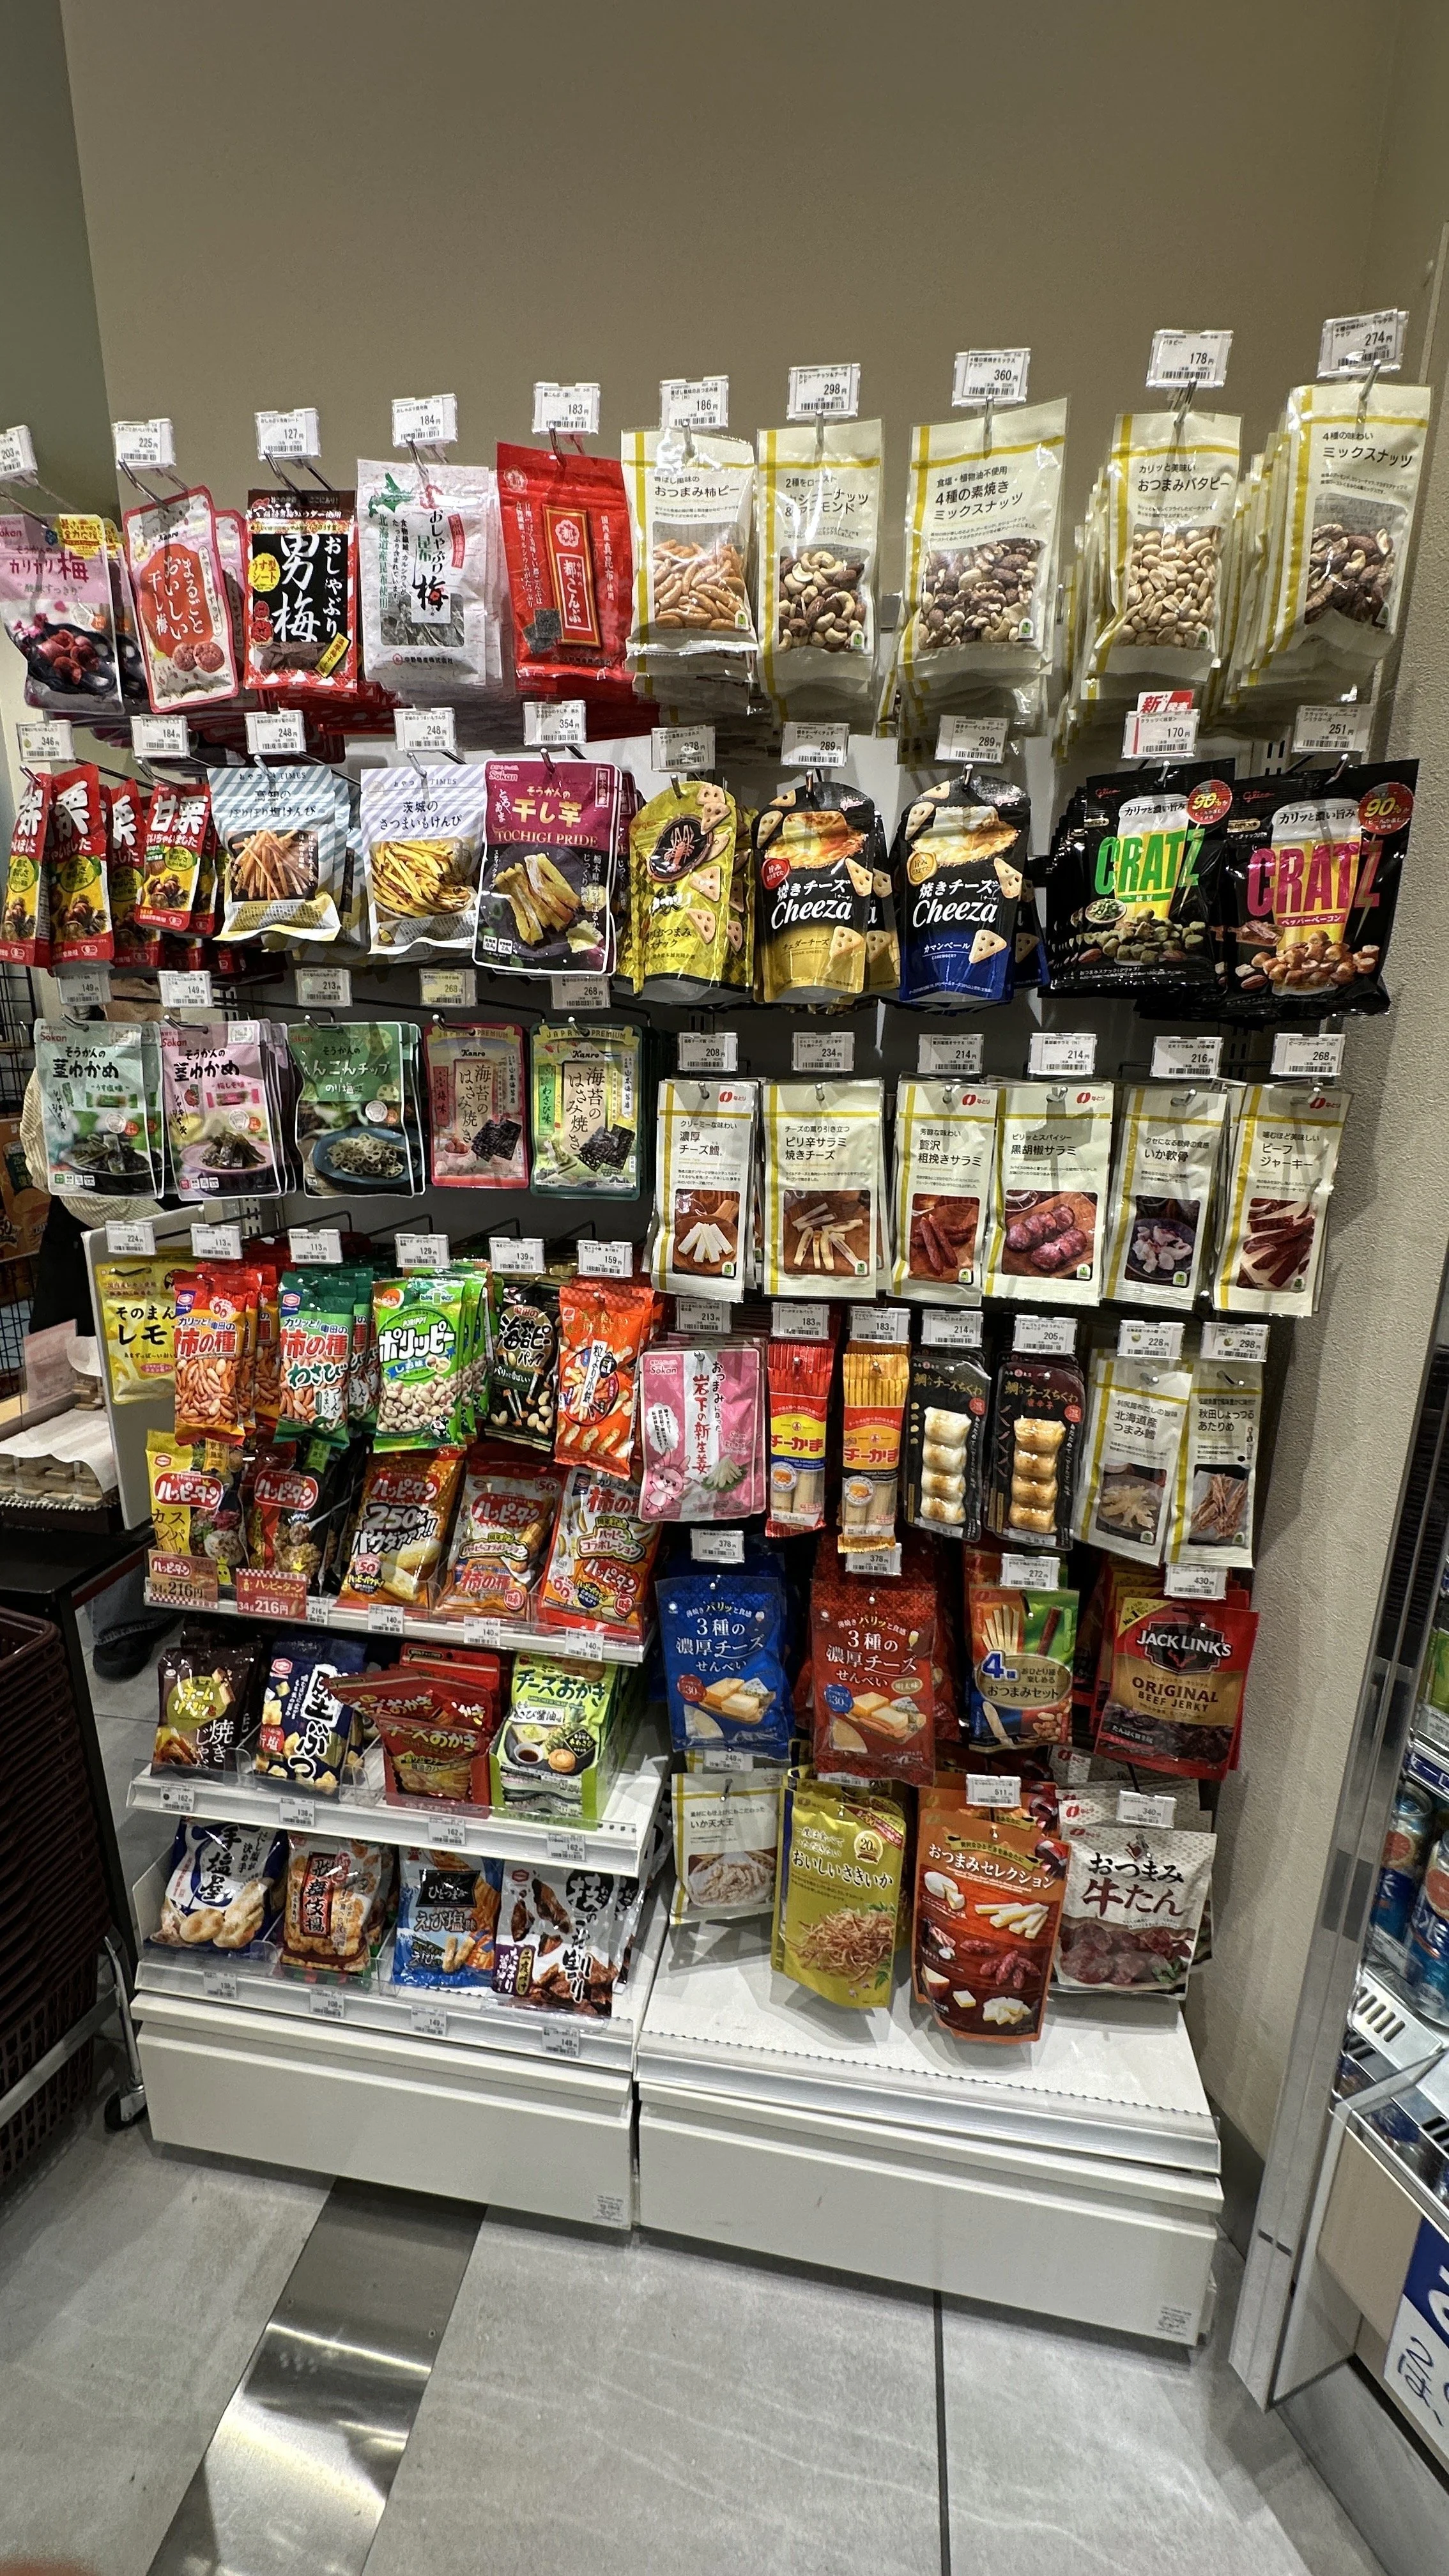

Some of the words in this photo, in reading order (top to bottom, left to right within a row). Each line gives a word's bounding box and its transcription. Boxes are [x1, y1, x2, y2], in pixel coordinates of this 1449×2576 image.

[1322, 431, 1374, 441] 4種の味わい
[1322, 445, 1413, 467] ミックスナッツ
[1139, 463, 1196, 473] カリッと美味い
[654, 485, 740, 498] おつまみ柿ピー
[935, 480, 1009, 505] 4種の素焼き
[1138, 478, 1230, 492] おつまみバタピー
[933, 492, 1023, 521] ミックスナッツ
[429, 509, 446, 576] おしゃぶり
[10, 552, 89, 584] カリカリ梅
[181, 557, 204, 634] まるごと
[271, 534, 320, 641] 男梅
[323, 535, 342, 638] おしゃぶり
[563, 559, 581, 624] 都こんぶ
[164, 556, 188, 639] おいしい
[279, 771, 306, 779] TIMES
[526, 786, 570, 799] そうかんの
[150, 794, 208, 834] 甘栗
[402, 801, 438, 813] 茨城の
[512, 798, 581, 828] 干し芋
[1124, 801, 1186, 817] カリッと濃い旨み
[379, 815, 461, 830] さつまいもけんぴ
[1279, 809, 1356, 825] カリッと濃い旨み
[497, 829, 551, 844] TOCHIGI
[556, 832, 598, 847] PRIDE
[1094, 828, 1205, 894] CRATZ
[1246, 839, 1385, 917] CRATZ
[776, 879, 850, 901] 焼きチーズ
[918, 879, 999, 900] 焼きチーズ
[771, 900, 852, 930] Cheeza
[912, 900, 999, 928] Cheeza
[1281, 915, 1341, 926] ペッパーベーコン
[477, 1029, 509, 1039] PREMIUM
[592, 1029, 626, 1039] PREMIUM
[65, 1047, 105, 1059] そうかんの
[185, 1049, 226, 1061] そうかんの
[323, 1045, 360, 1055] そうかんの
[461, 1048, 486, 1058] Kanro
[572, 1050, 599, 1060] Kanro
[53, 1059, 119, 1078] 茎わかめ
[174, 1061, 240, 1082] 茎わかめ
[475, 1064, 491, 1115] 海苔の
[586, 1066, 605, 1119] 海苔の
[459, 1070, 478, 1142] はさみ焼き
[541, 1087, 553, 1123] わさび味
[566, 1073, 588, 1151] はさみ焼き
[680, 1120, 737, 1130] クリーミーな味わい
[920, 1128, 960, 1137] 芳醇な味わい
[680, 1131, 700, 1142] 濃厚
[785, 1137, 847, 1147] ピリ辛サラミ
[919, 1140, 940, 1151] 贅沢
[1146, 1137, 1209, 1149] クセになる軟骨の食感
[785, 1149, 835, 1160] 焼きチーズ
[1011, 1144, 1076, 1156] 黒胡椒サラミ
[1144, 1149, 1188, 1163] いか軟骨
[1262, 1144, 1293, 1154] ビーフ
[918, 1153, 981, 1167] 粗挽きサラミ
[1261, 1155, 1313, 1167] ジャーキー
[211, 1322, 235, 1331] 亀田の
[320, 1324, 348, 1334] 亀田の
[174, 1328, 236, 1358] 柿の種
[280, 1330, 349, 1359] 柿の種
[518, 1351, 542, 1366] パック
[287, 1360, 349, 1390] わさび
[650, 1366, 677, 1374] Sokan
[1114, 1411, 1158, 1428] 北海道産
[1199, 1408, 1255, 1420] 秋田しょっつる
[692, 1374, 712, 1475] 岩下の新生姜
[1198, 1421, 1234, 1432] あたりめ
[771, 1434, 823, 1452] チーかま
[844, 1446, 898, 1463] チーかま
[696, 1618, 745, 1636] 3種の
[676, 1635, 764, 1658] 濃厚チーズ
[847, 1630, 898, 1651] 3種の
[1137, 1631, 1180, 1650] JACK
[1181, 1633, 1232, 1657] LINK'S
[695, 1662, 746, 1672] せんべい
[827, 1644, 917, 1676] 濃厚チーズ
[515, 1669, 605, 1706] チーズおかき
[836, 1671, 888, 1688] せんべい
[987, 1686, 1059, 1699] おつまみセット
[1132, 1678, 1218, 1703] ORIGINAL
[1138, 1692, 1165, 1706] BEEF
[1171, 1698, 1209, 1712] JERKY
[210, 1719, 233, 1762] 焼き
[691, 1818, 733, 1828] いか天大王
[793, 1851, 893, 1890] おいしいさきいか
[929, 1843, 1057, 1889] おつまみセレクション
[1087, 1853, 1184, 1883] おつまみ
[1082, 1878, 1185, 1916] 牛たん
[414, 1912, 476, 1932] えび塩味
